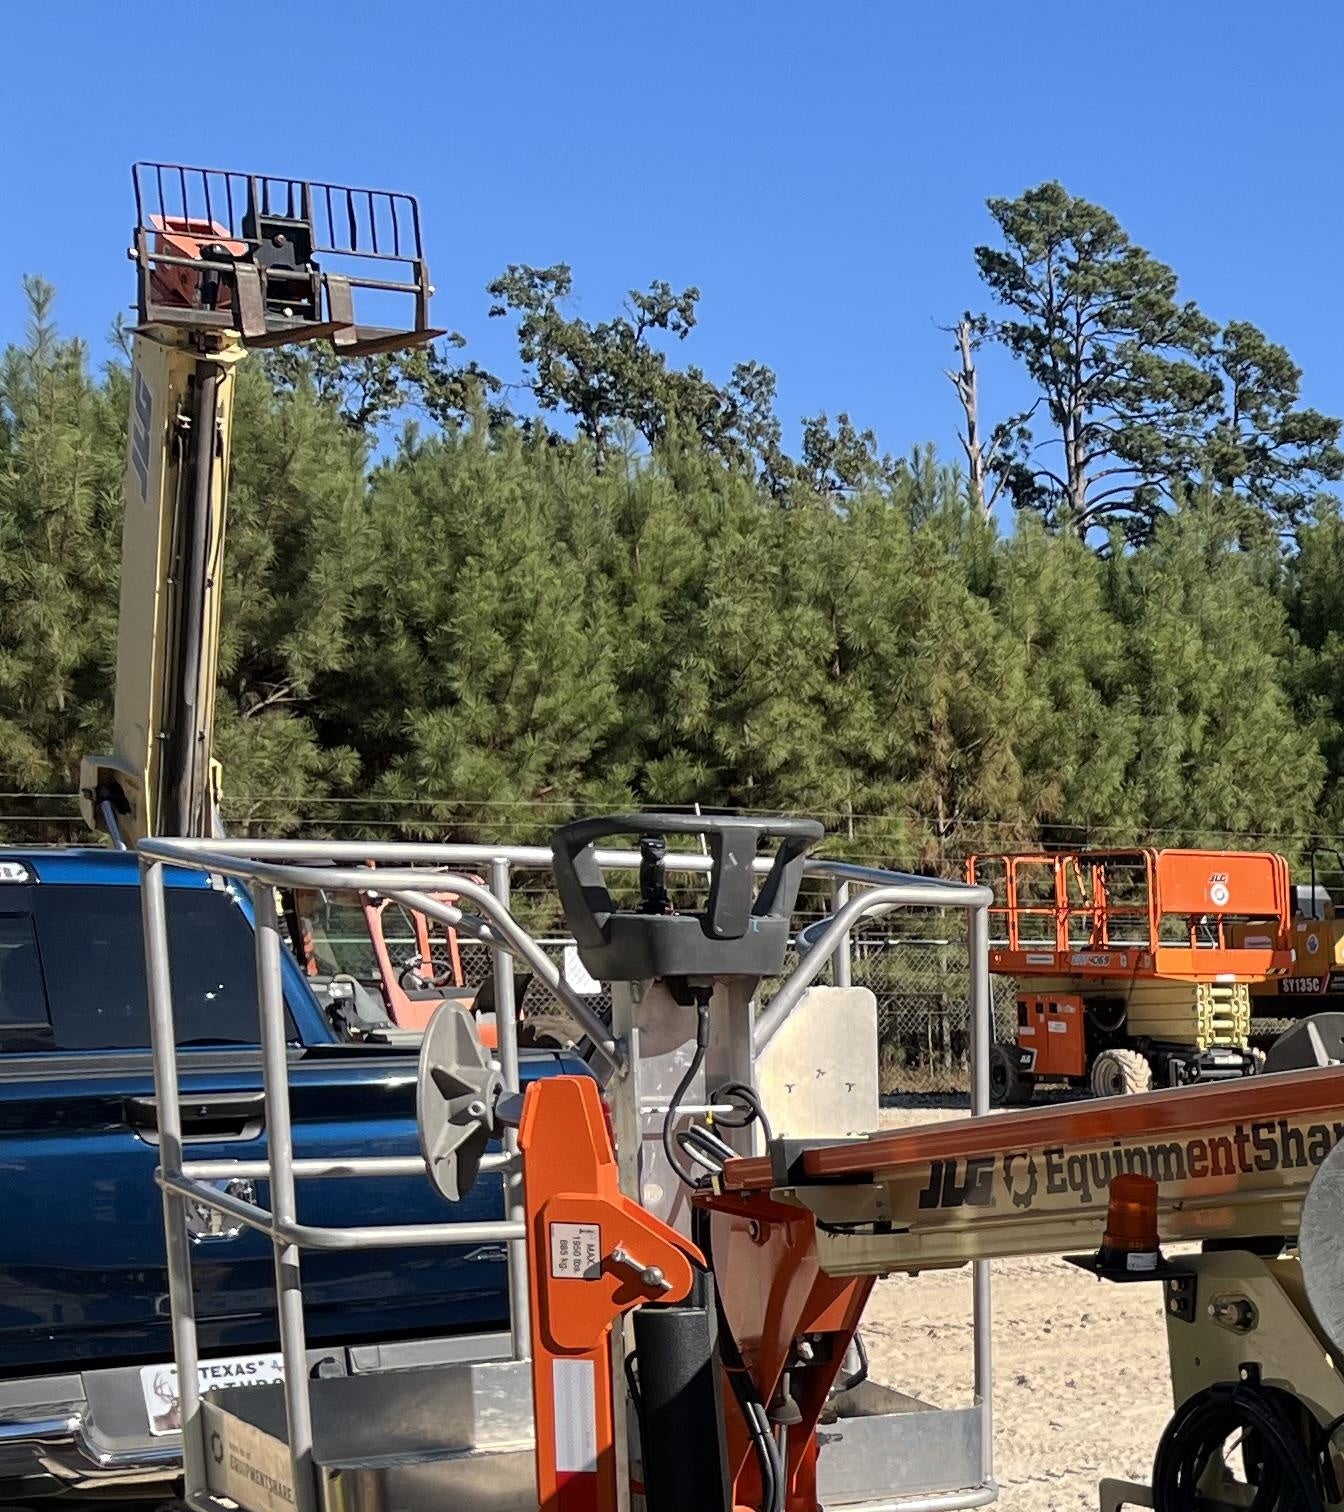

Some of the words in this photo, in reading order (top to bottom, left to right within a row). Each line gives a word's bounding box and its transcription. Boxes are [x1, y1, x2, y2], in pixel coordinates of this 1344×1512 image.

[1282, 977, 1319, 993] SY135C
[919, 1157, 995, 1209] JLG
[200, 1362, 256, 1379] TEXAS
